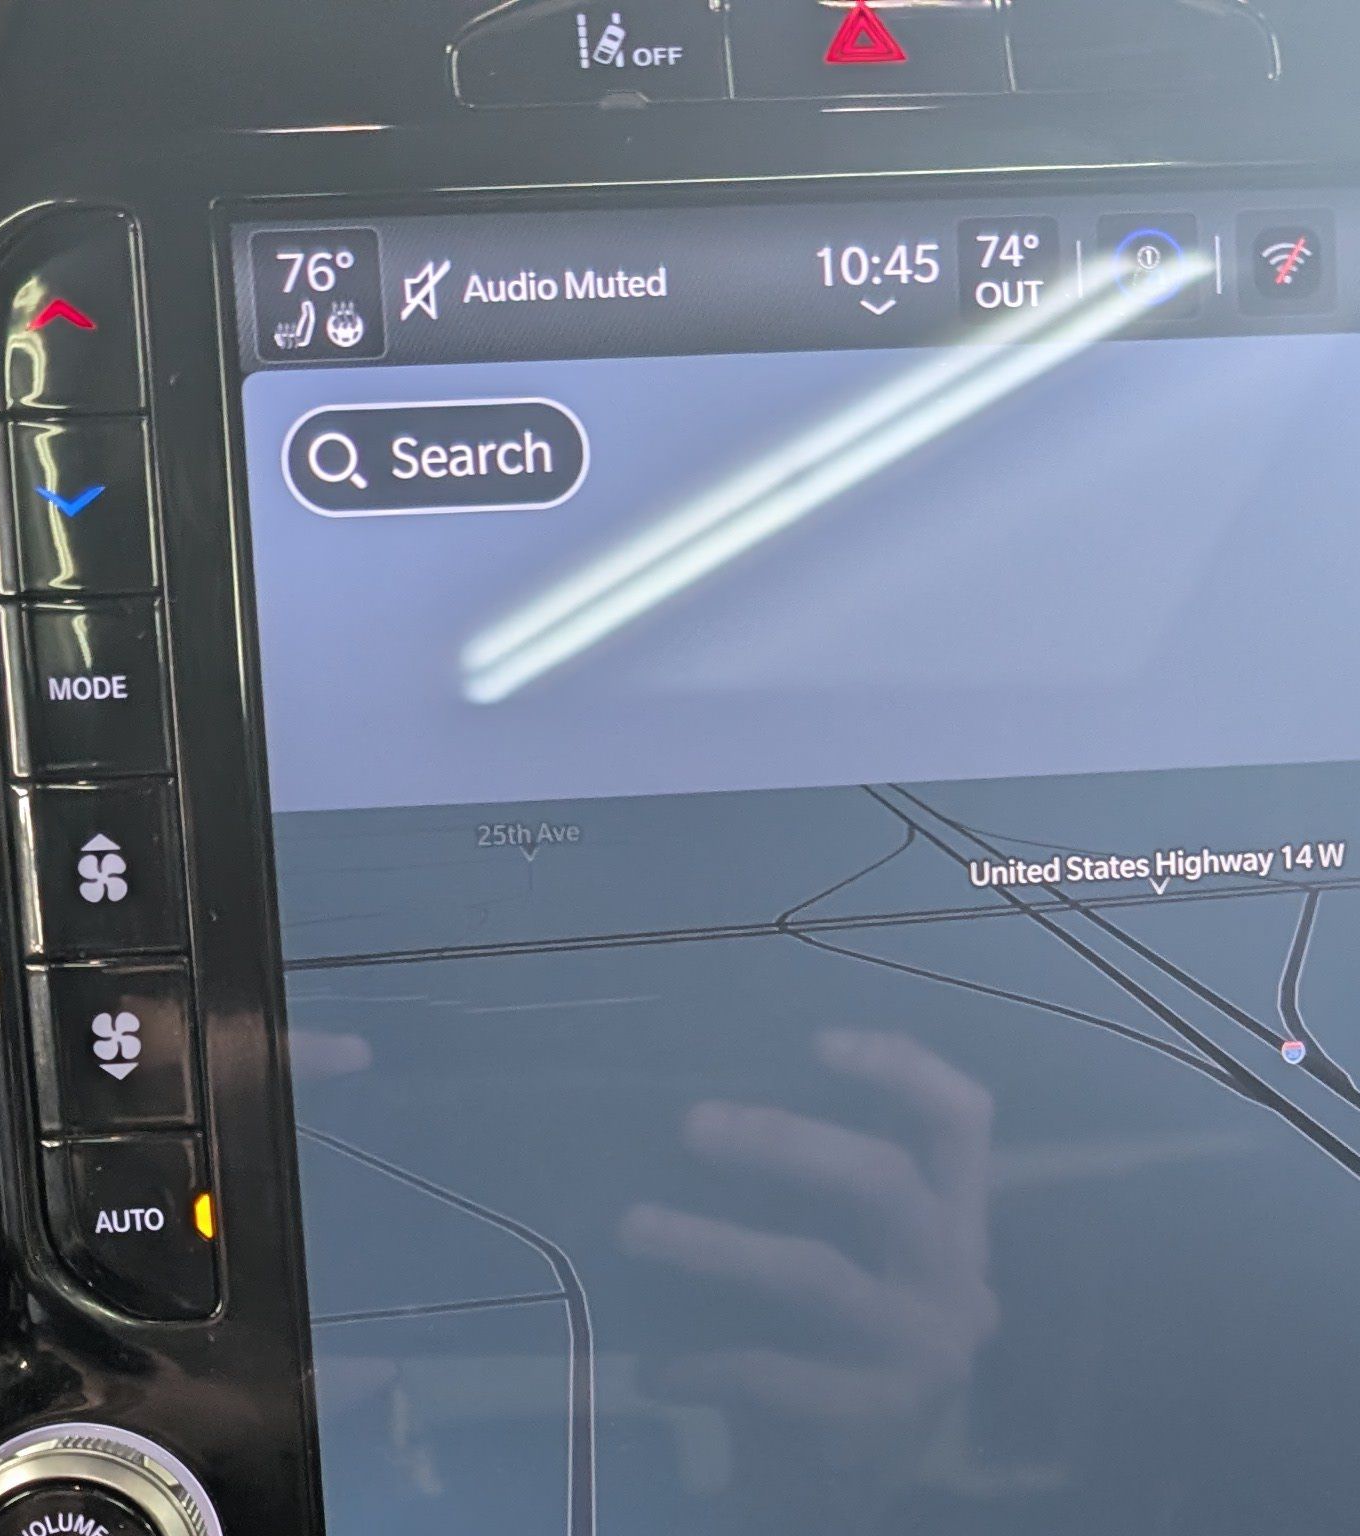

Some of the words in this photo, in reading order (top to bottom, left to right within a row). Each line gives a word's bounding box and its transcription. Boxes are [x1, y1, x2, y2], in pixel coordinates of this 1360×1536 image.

[632, 46, 683, 68] OFF
[816, 242, 940, 287] 10:45
[975, 232, 1040, 269] 74°
[275, 249, 354, 293] 76°
[463, 270, 558, 304] Audio
[564, 266, 667, 301] Muted
[974, 279, 1043, 309] OUT
[391, 429, 553, 481] Search
[47, 675, 128, 701] MODE
[477, 822, 532, 848] 25th
[535, 821, 581, 844] Ave
[969, 855, 1061, 888] United
[1065, 852, 1150, 883] States
[1154, 847, 1274, 881] Highway
[1280, 844, 1314, 870] 14
[1316, 842, 1346, 868] W
[95, 1207, 165, 1234] AUTO
